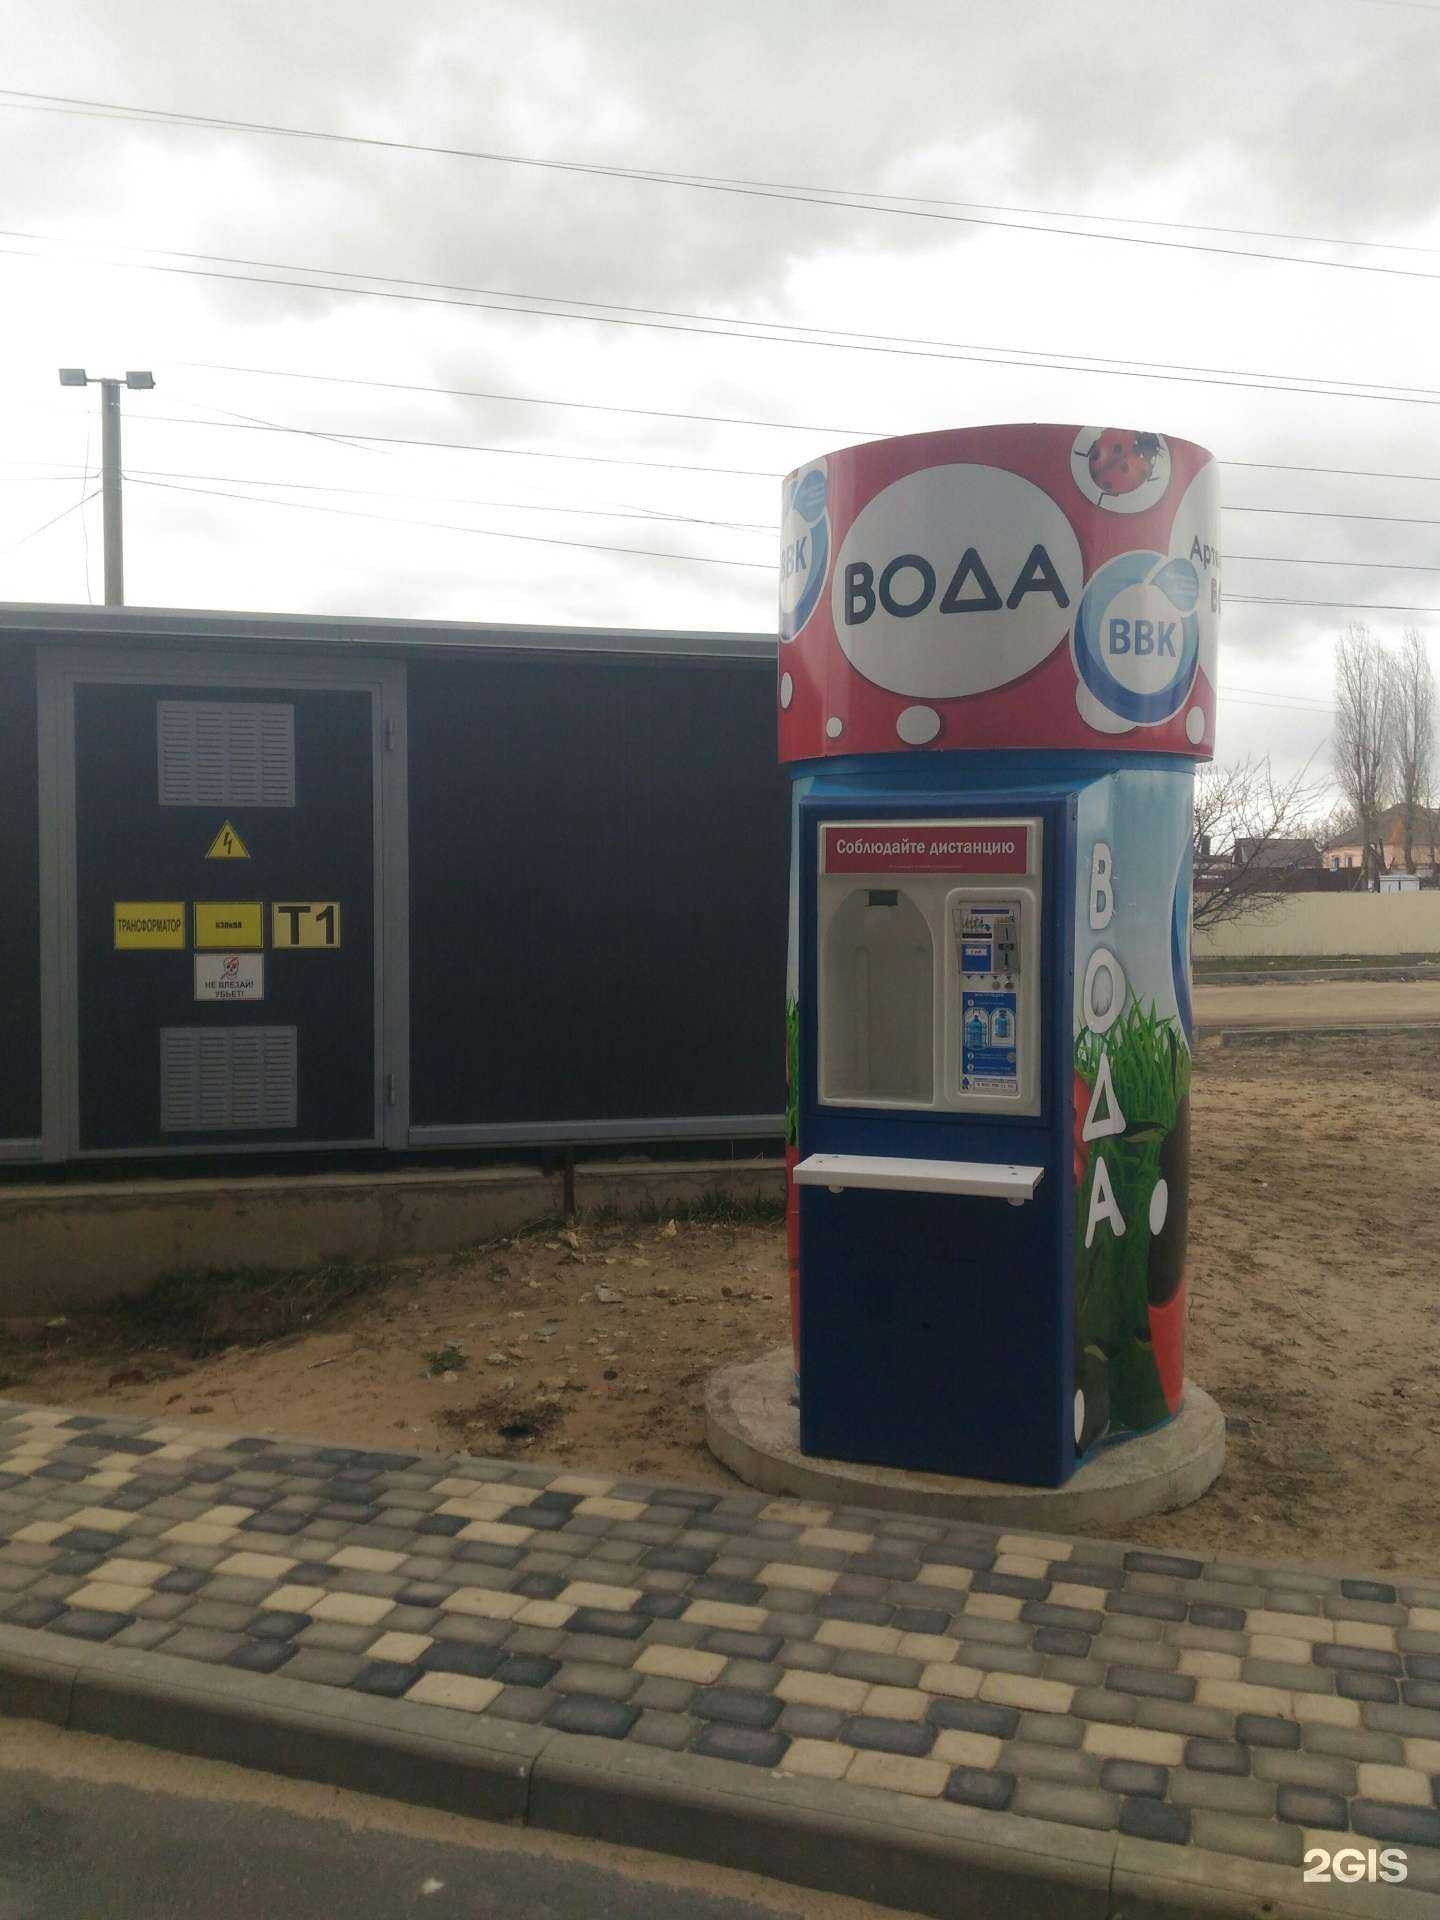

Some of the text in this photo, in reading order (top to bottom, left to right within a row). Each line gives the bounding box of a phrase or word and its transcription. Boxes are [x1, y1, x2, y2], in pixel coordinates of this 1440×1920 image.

[844, 543, 1070, 625] ВОДА
[1108, 617, 1177, 658] ВВК
[836, 838, 1016, 857] Соблюдайте дистанцию
[118, 918, 182, 933] ТРАНСФОРМАТОР
[278, 905, 335, 945] Т1
[204, 979, 254, 989] НЕ ВЛЕЗАЙ!
[1083, 842, 1127, 1249] ВОДА
